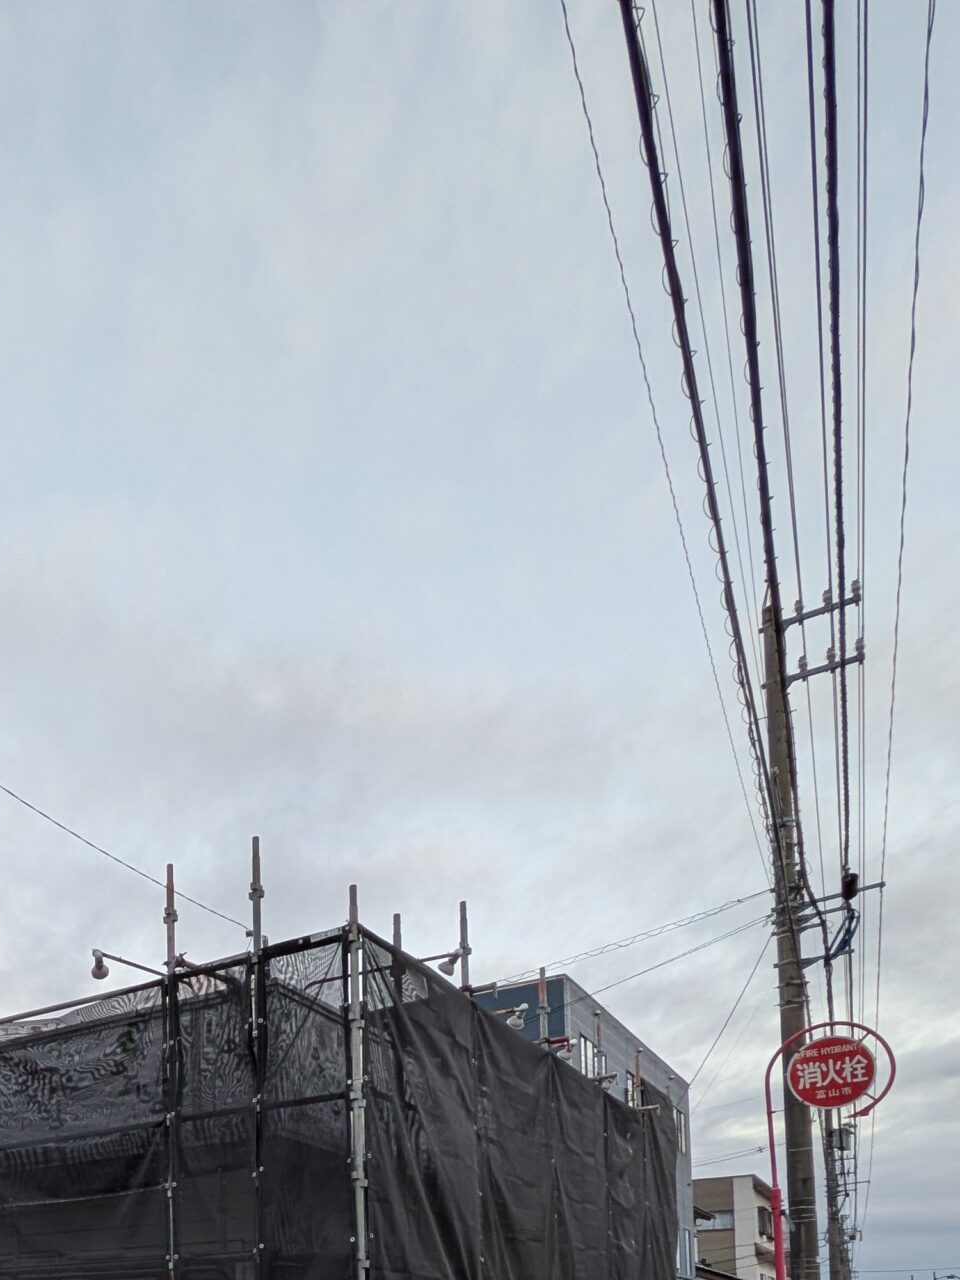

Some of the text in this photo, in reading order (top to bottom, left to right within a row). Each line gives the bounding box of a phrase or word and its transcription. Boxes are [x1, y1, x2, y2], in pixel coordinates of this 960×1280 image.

[801, 1043, 857, 1058] FIRE HYDRANT
[796, 1054, 869, 1089] 消火栓
[815, 1086, 852, 1099] 富山市
